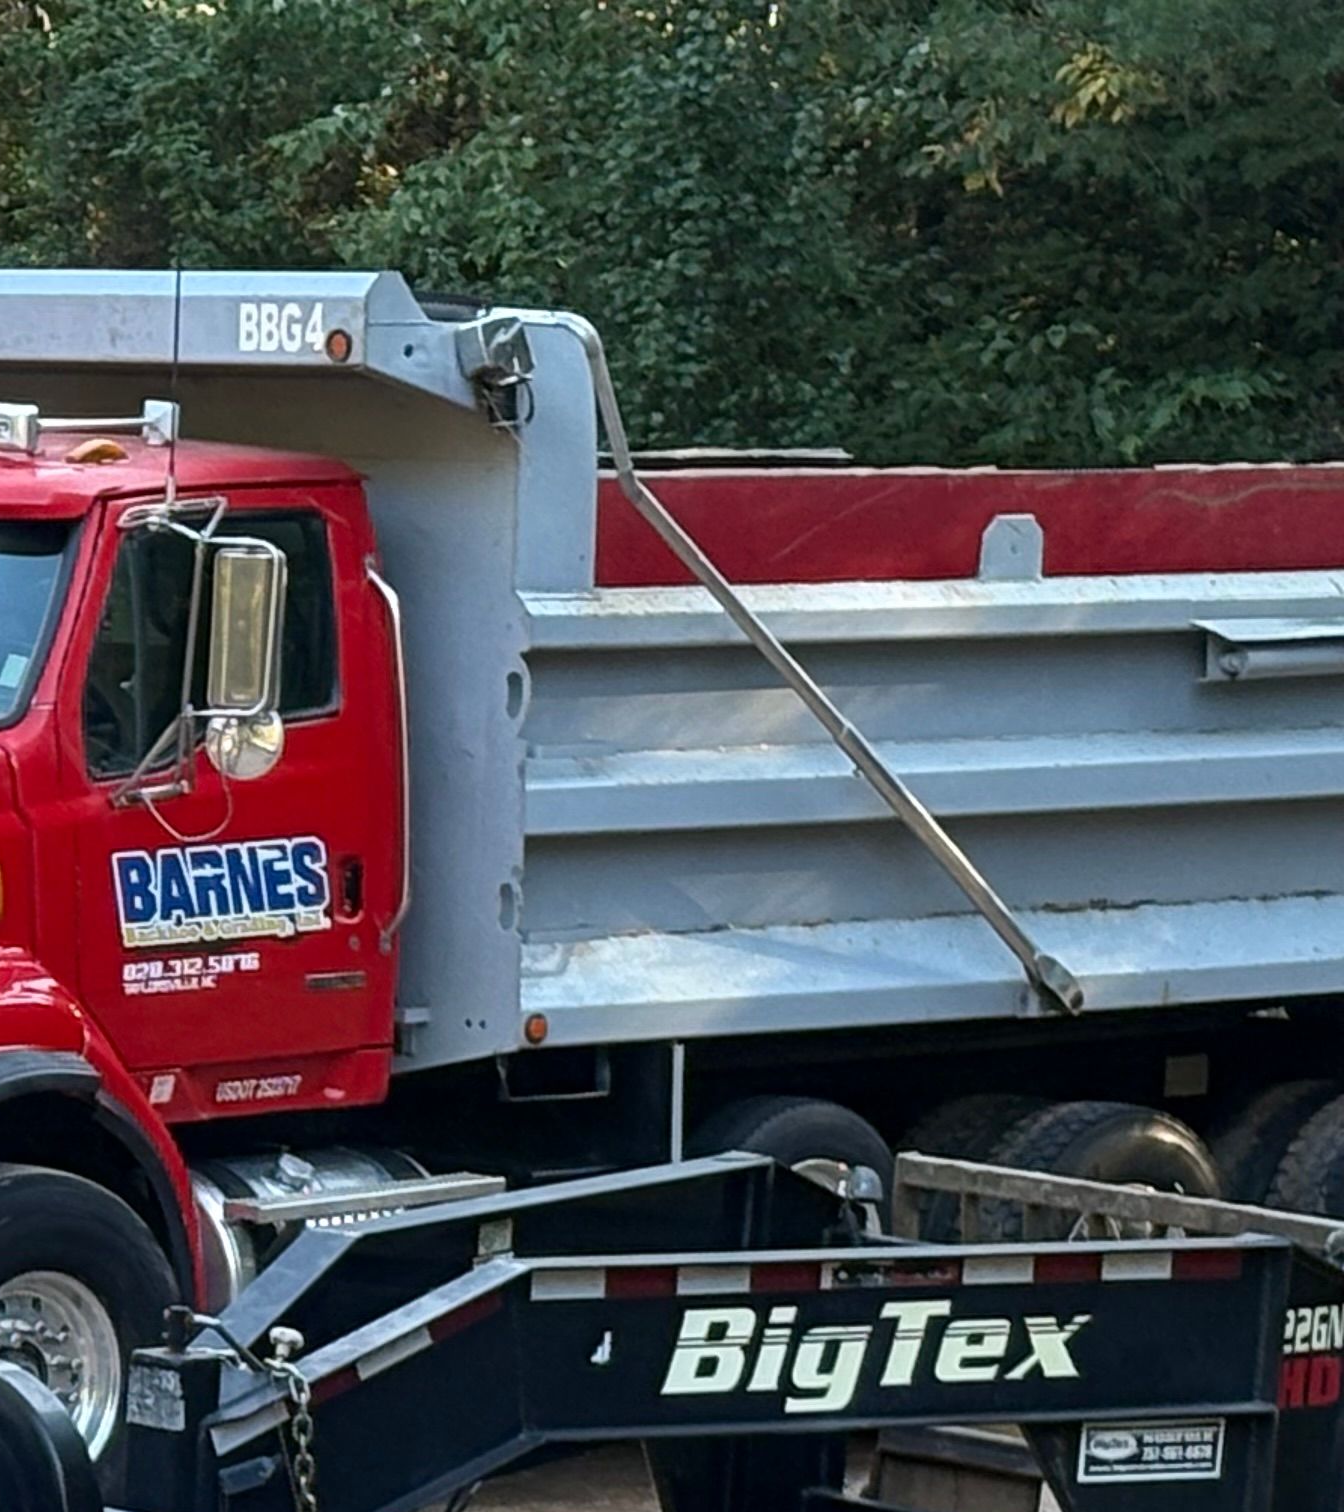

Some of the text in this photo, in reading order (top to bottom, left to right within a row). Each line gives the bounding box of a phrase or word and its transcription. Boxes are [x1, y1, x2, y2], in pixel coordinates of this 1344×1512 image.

[239, 302, 324, 353] BBG4
[114, 838, 328, 925] BARNES
[660, 1299, 1093, 1414] BigTex
